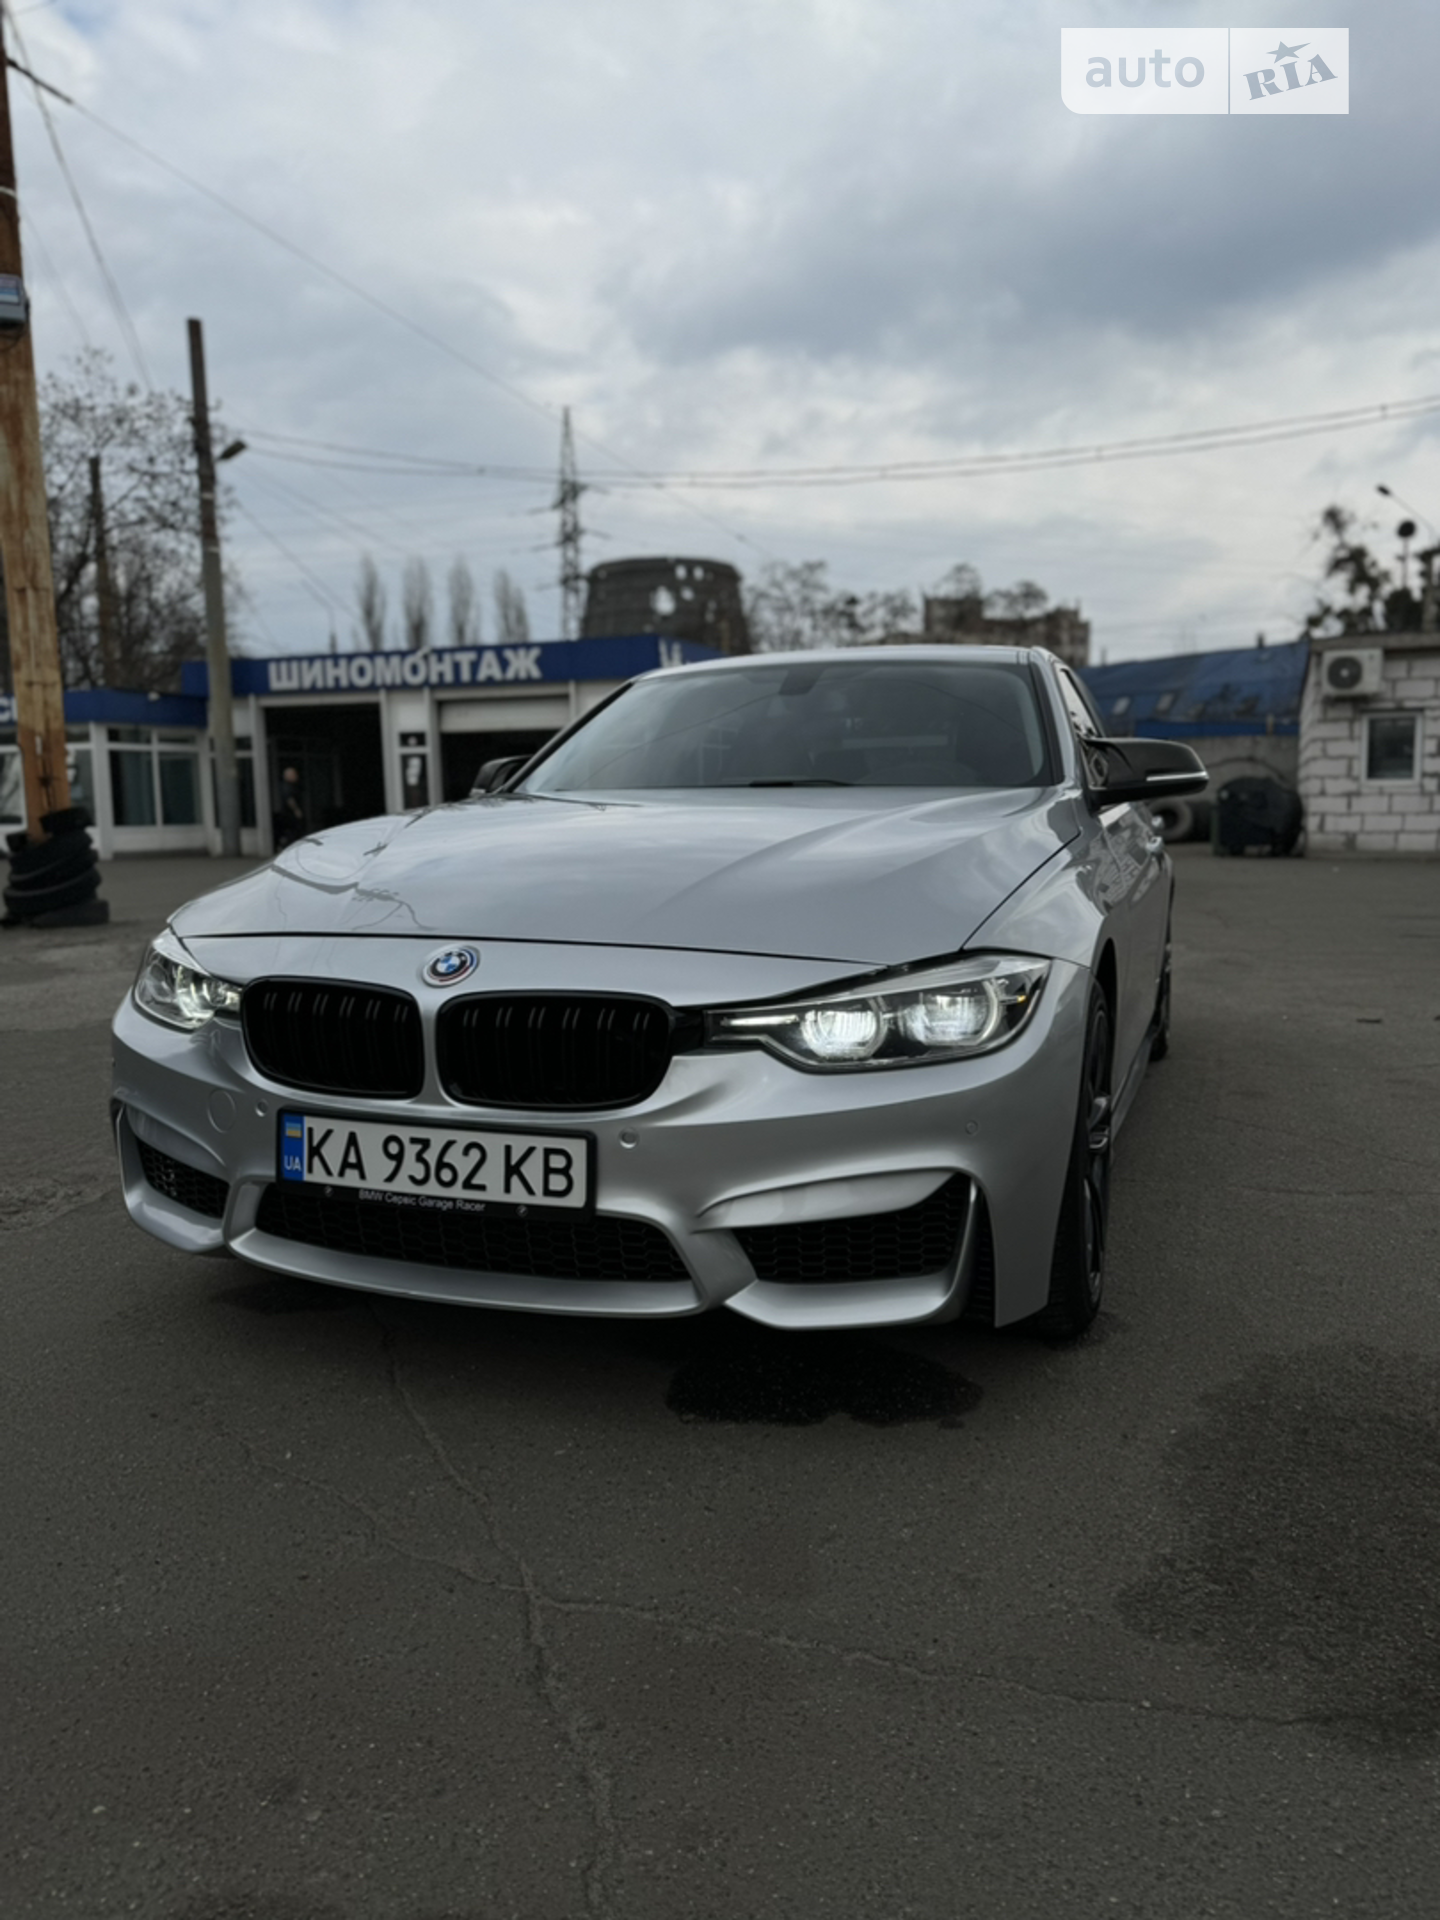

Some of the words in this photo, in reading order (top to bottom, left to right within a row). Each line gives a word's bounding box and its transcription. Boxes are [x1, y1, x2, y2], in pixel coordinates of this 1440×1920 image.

[268, 647, 542, 691] ШИНОМОНТАЖ
[284, 1154, 303, 1172] UA
[306, 1126, 366, 1180] KA
[381, 1134, 488, 1192] 9362
[503, 1145, 574, 1198] KB
[358, 1190, 383, 1201] BMW
[418, 1196, 454, 1211] Garage
[456, 1200, 486, 1212] Racer
